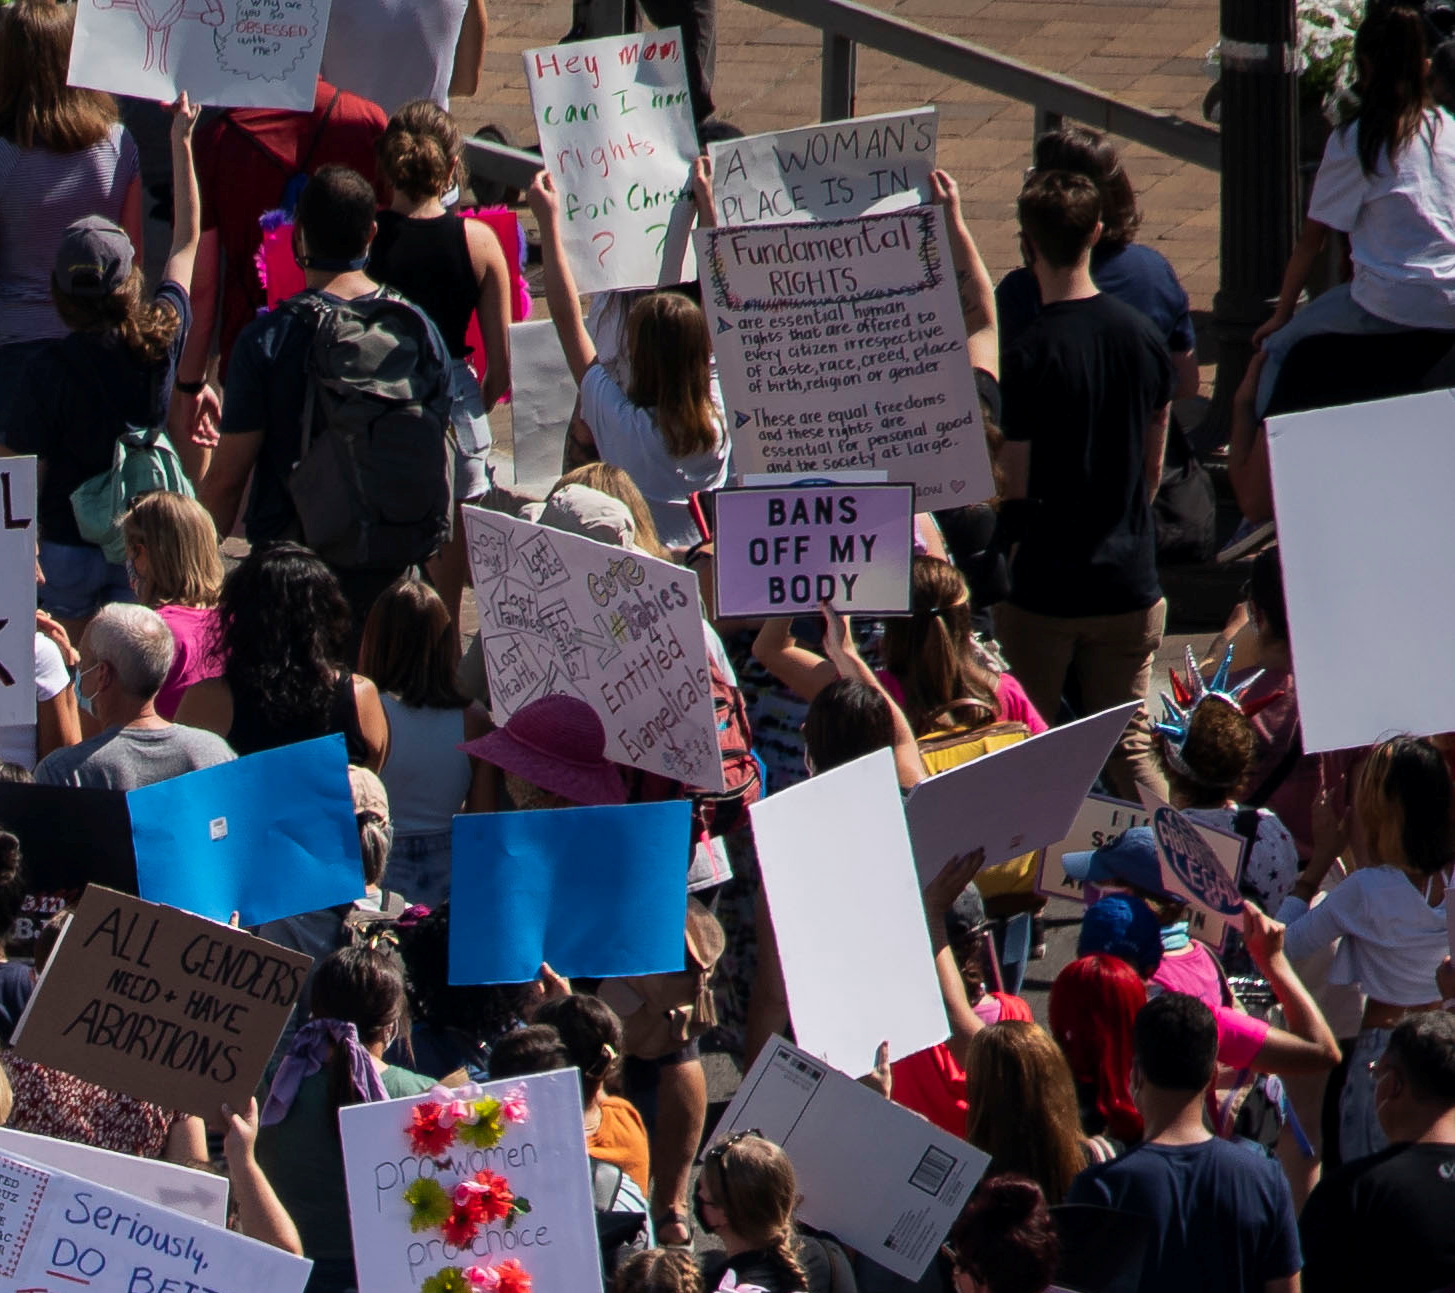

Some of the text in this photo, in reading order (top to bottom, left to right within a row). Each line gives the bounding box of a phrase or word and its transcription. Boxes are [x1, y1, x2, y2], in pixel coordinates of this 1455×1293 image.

[724, 119, 932, 185] A WOMAN'S
[721, 168, 911, 226] PLACE IS IN
[731, 221, 912, 267] Fundamental
[768, 267, 858, 298] RIGHTS
[738, 300, 905, 331] are essential human
[65, 1192, 208, 1274] Seriously,
[52, 1237, 105, 1277] DO
